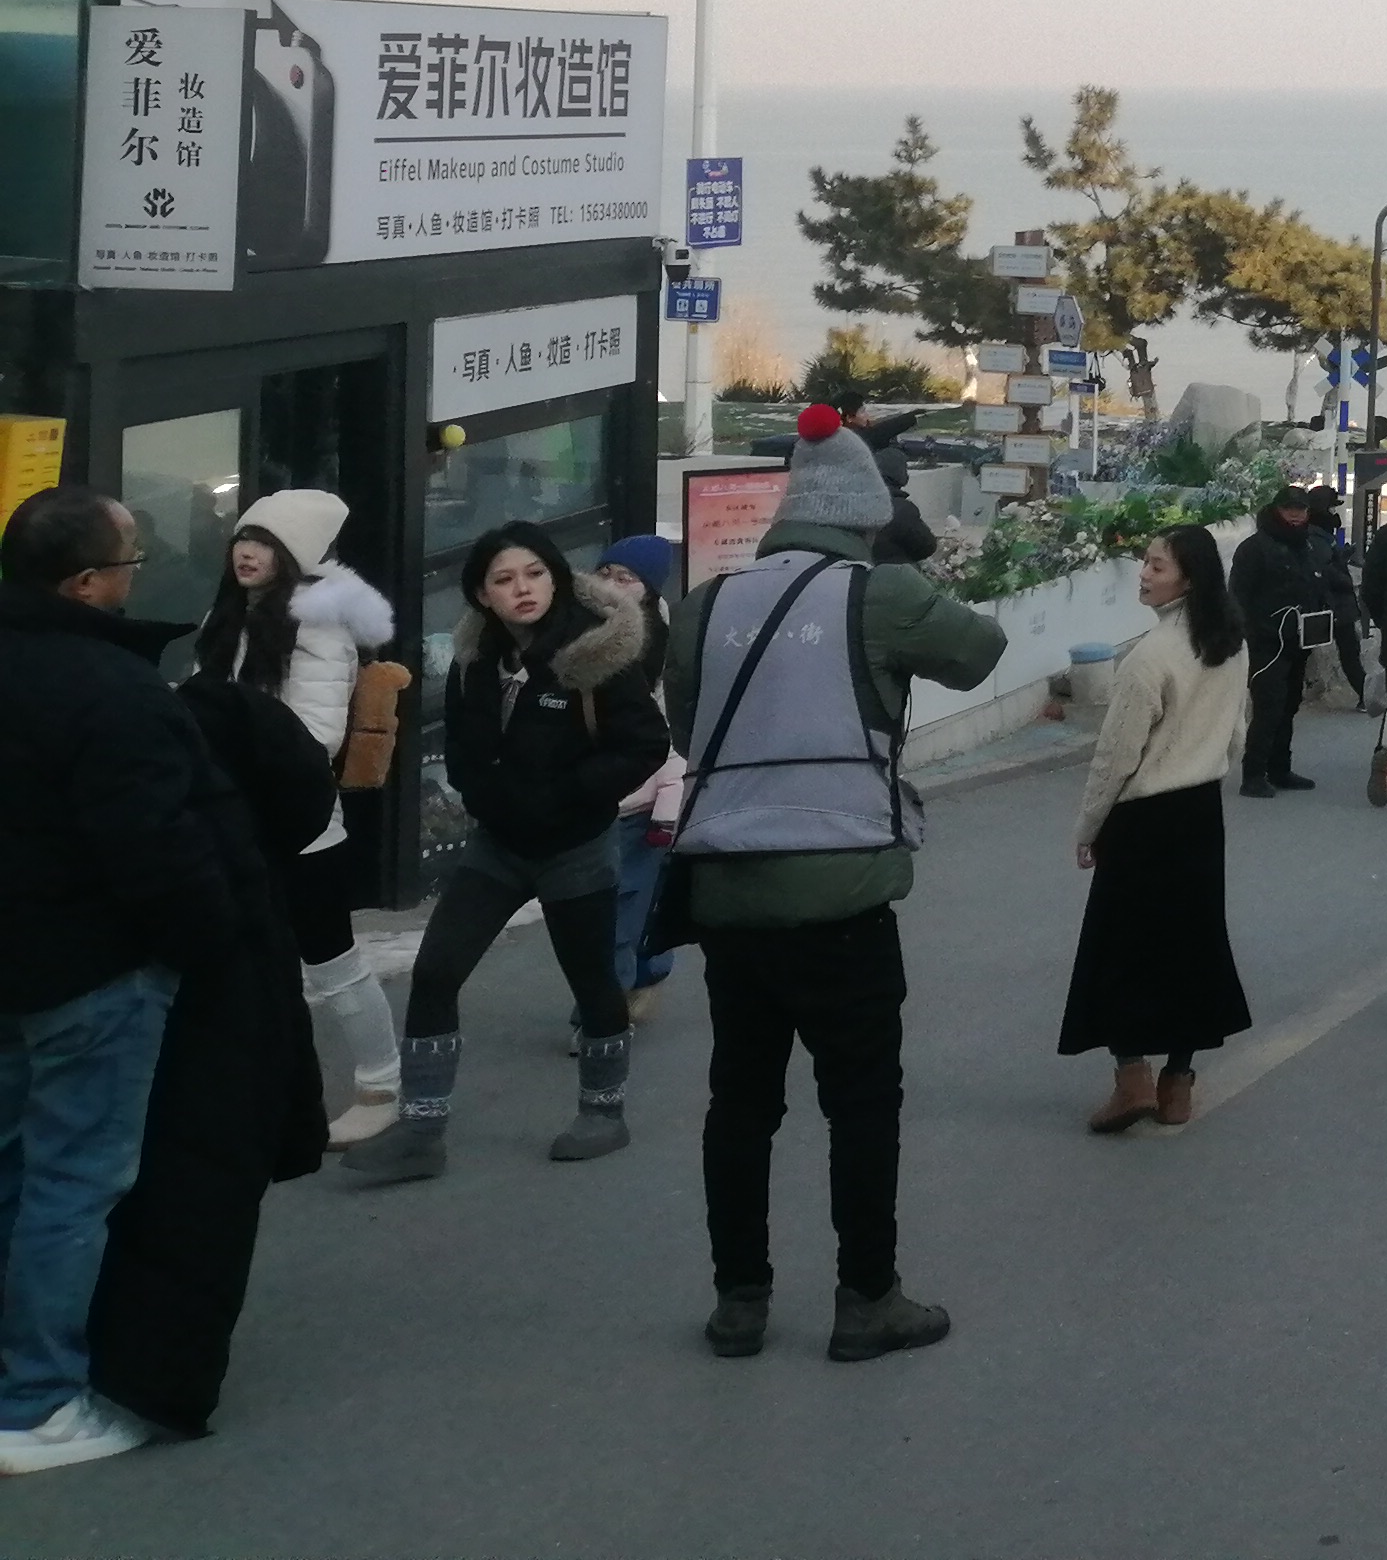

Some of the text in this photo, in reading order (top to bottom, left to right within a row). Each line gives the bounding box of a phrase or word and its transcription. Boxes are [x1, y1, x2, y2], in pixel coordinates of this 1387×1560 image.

[118, 27, 164, 167] 爱菲尔
[175, 71, 207, 168] 妆造馆
[375, 31, 633, 121] 爱菲尔妆造馆
[378, 151, 626, 184] Eiffel Makeup and Costume Studio
[549, 206, 574, 225] TEL:
[580, 200, 650, 223] 15634380000
